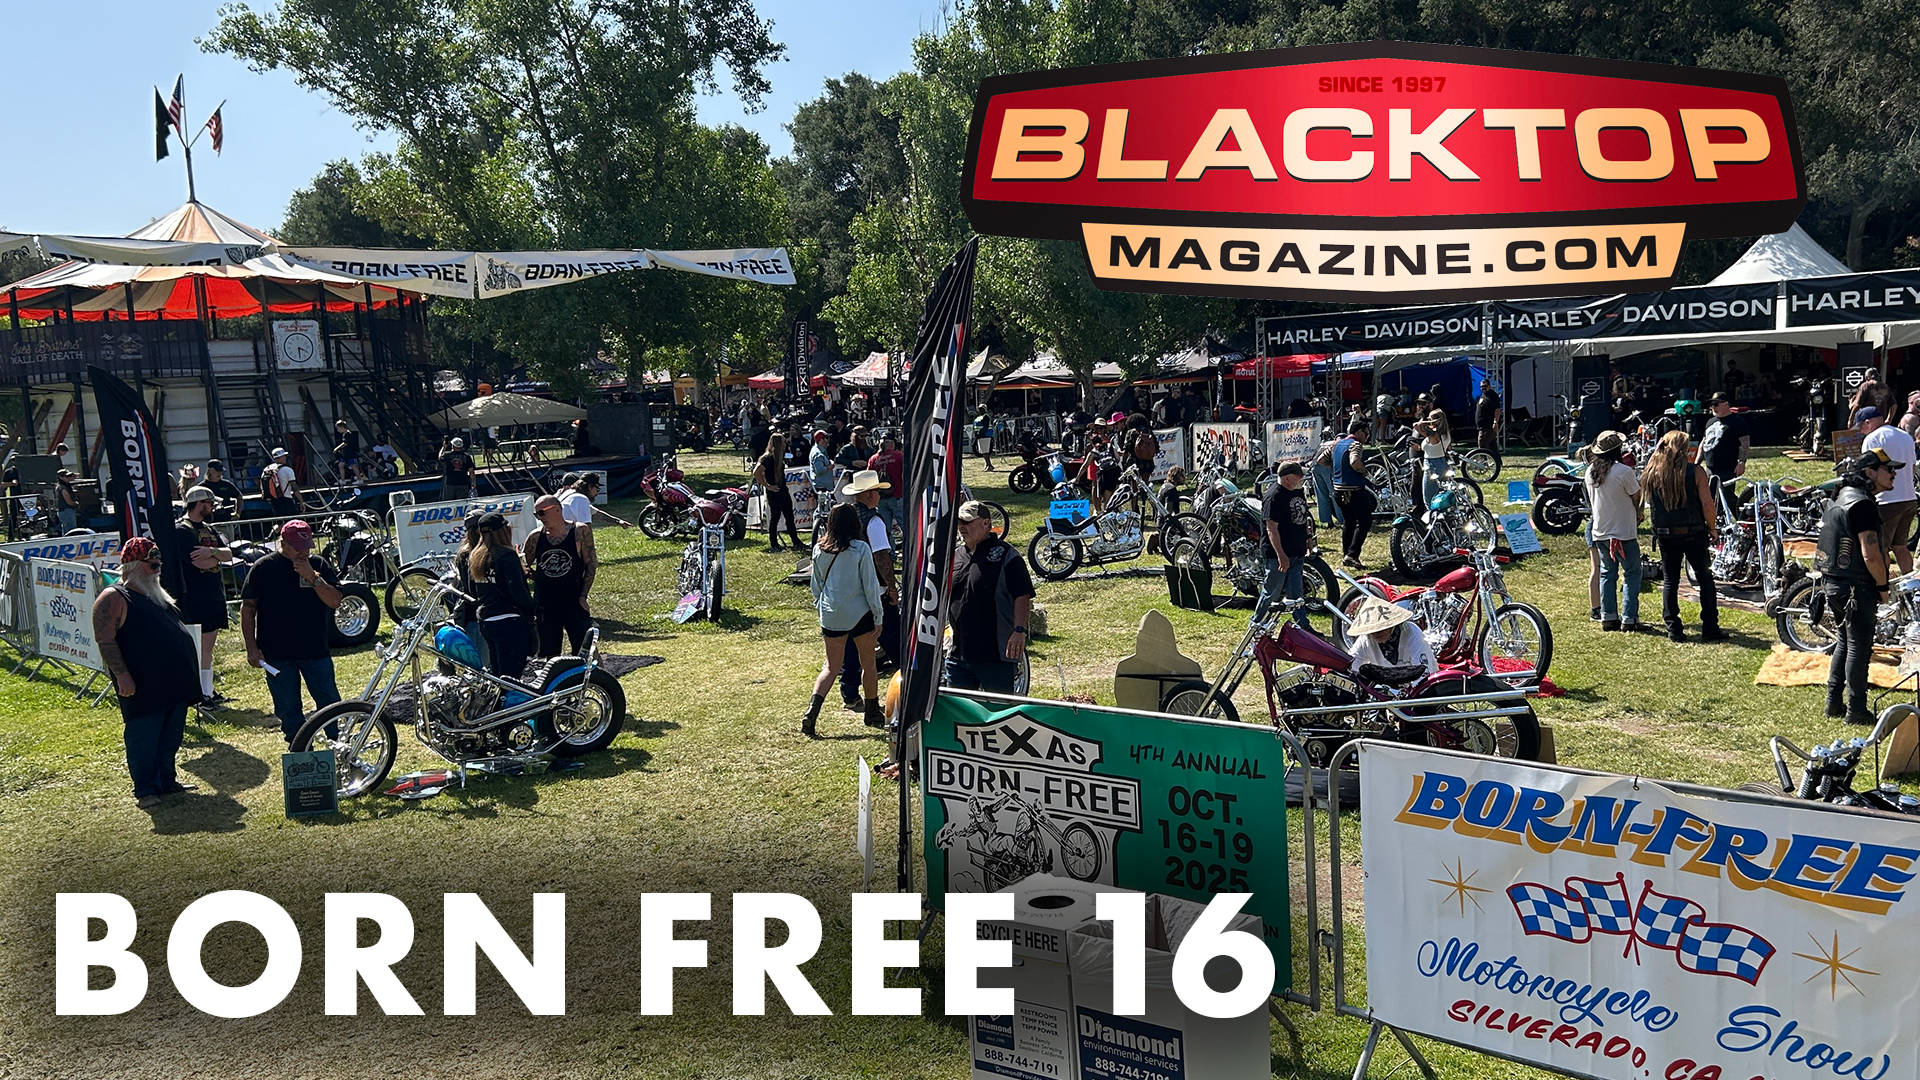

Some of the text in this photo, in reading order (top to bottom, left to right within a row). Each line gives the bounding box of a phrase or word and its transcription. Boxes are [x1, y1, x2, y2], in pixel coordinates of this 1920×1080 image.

[36, 353, 49, 363] OF
[51, 350, 83, 361] DEATH
[409, 499, 524, 526] BORNFREE
[23, 539, 121, 563] BORN-F
[36, 566, 86, 593] BORN-FREE
[966, 725, 1086, 765] TEXAS
[1129, 744, 1267, 780] 4TH ANNUAL
[936, 758, 1134, 818] BORN-FREE
[1168, 785, 1244, 826] OCT.
[1157, 819, 1254, 864] 16-19
[1398, 770, 1919, 911] BORN-FREE
[1164, 856, 1250, 893] 2025
[977, 922, 1059, 953] ECYCLE HERE
[1020, 1008, 1058, 1021] RESTROOMS
[1417, 937, 1890, 1080] Motorcycle Show
[978, 1020, 1012, 1034] Diamond
[1080, 1014, 1180, 1060] Diamond
[984, 1048, 1059, 1076] 888-744-7191
[1083, 1040, 1179, 1072] environmental services
